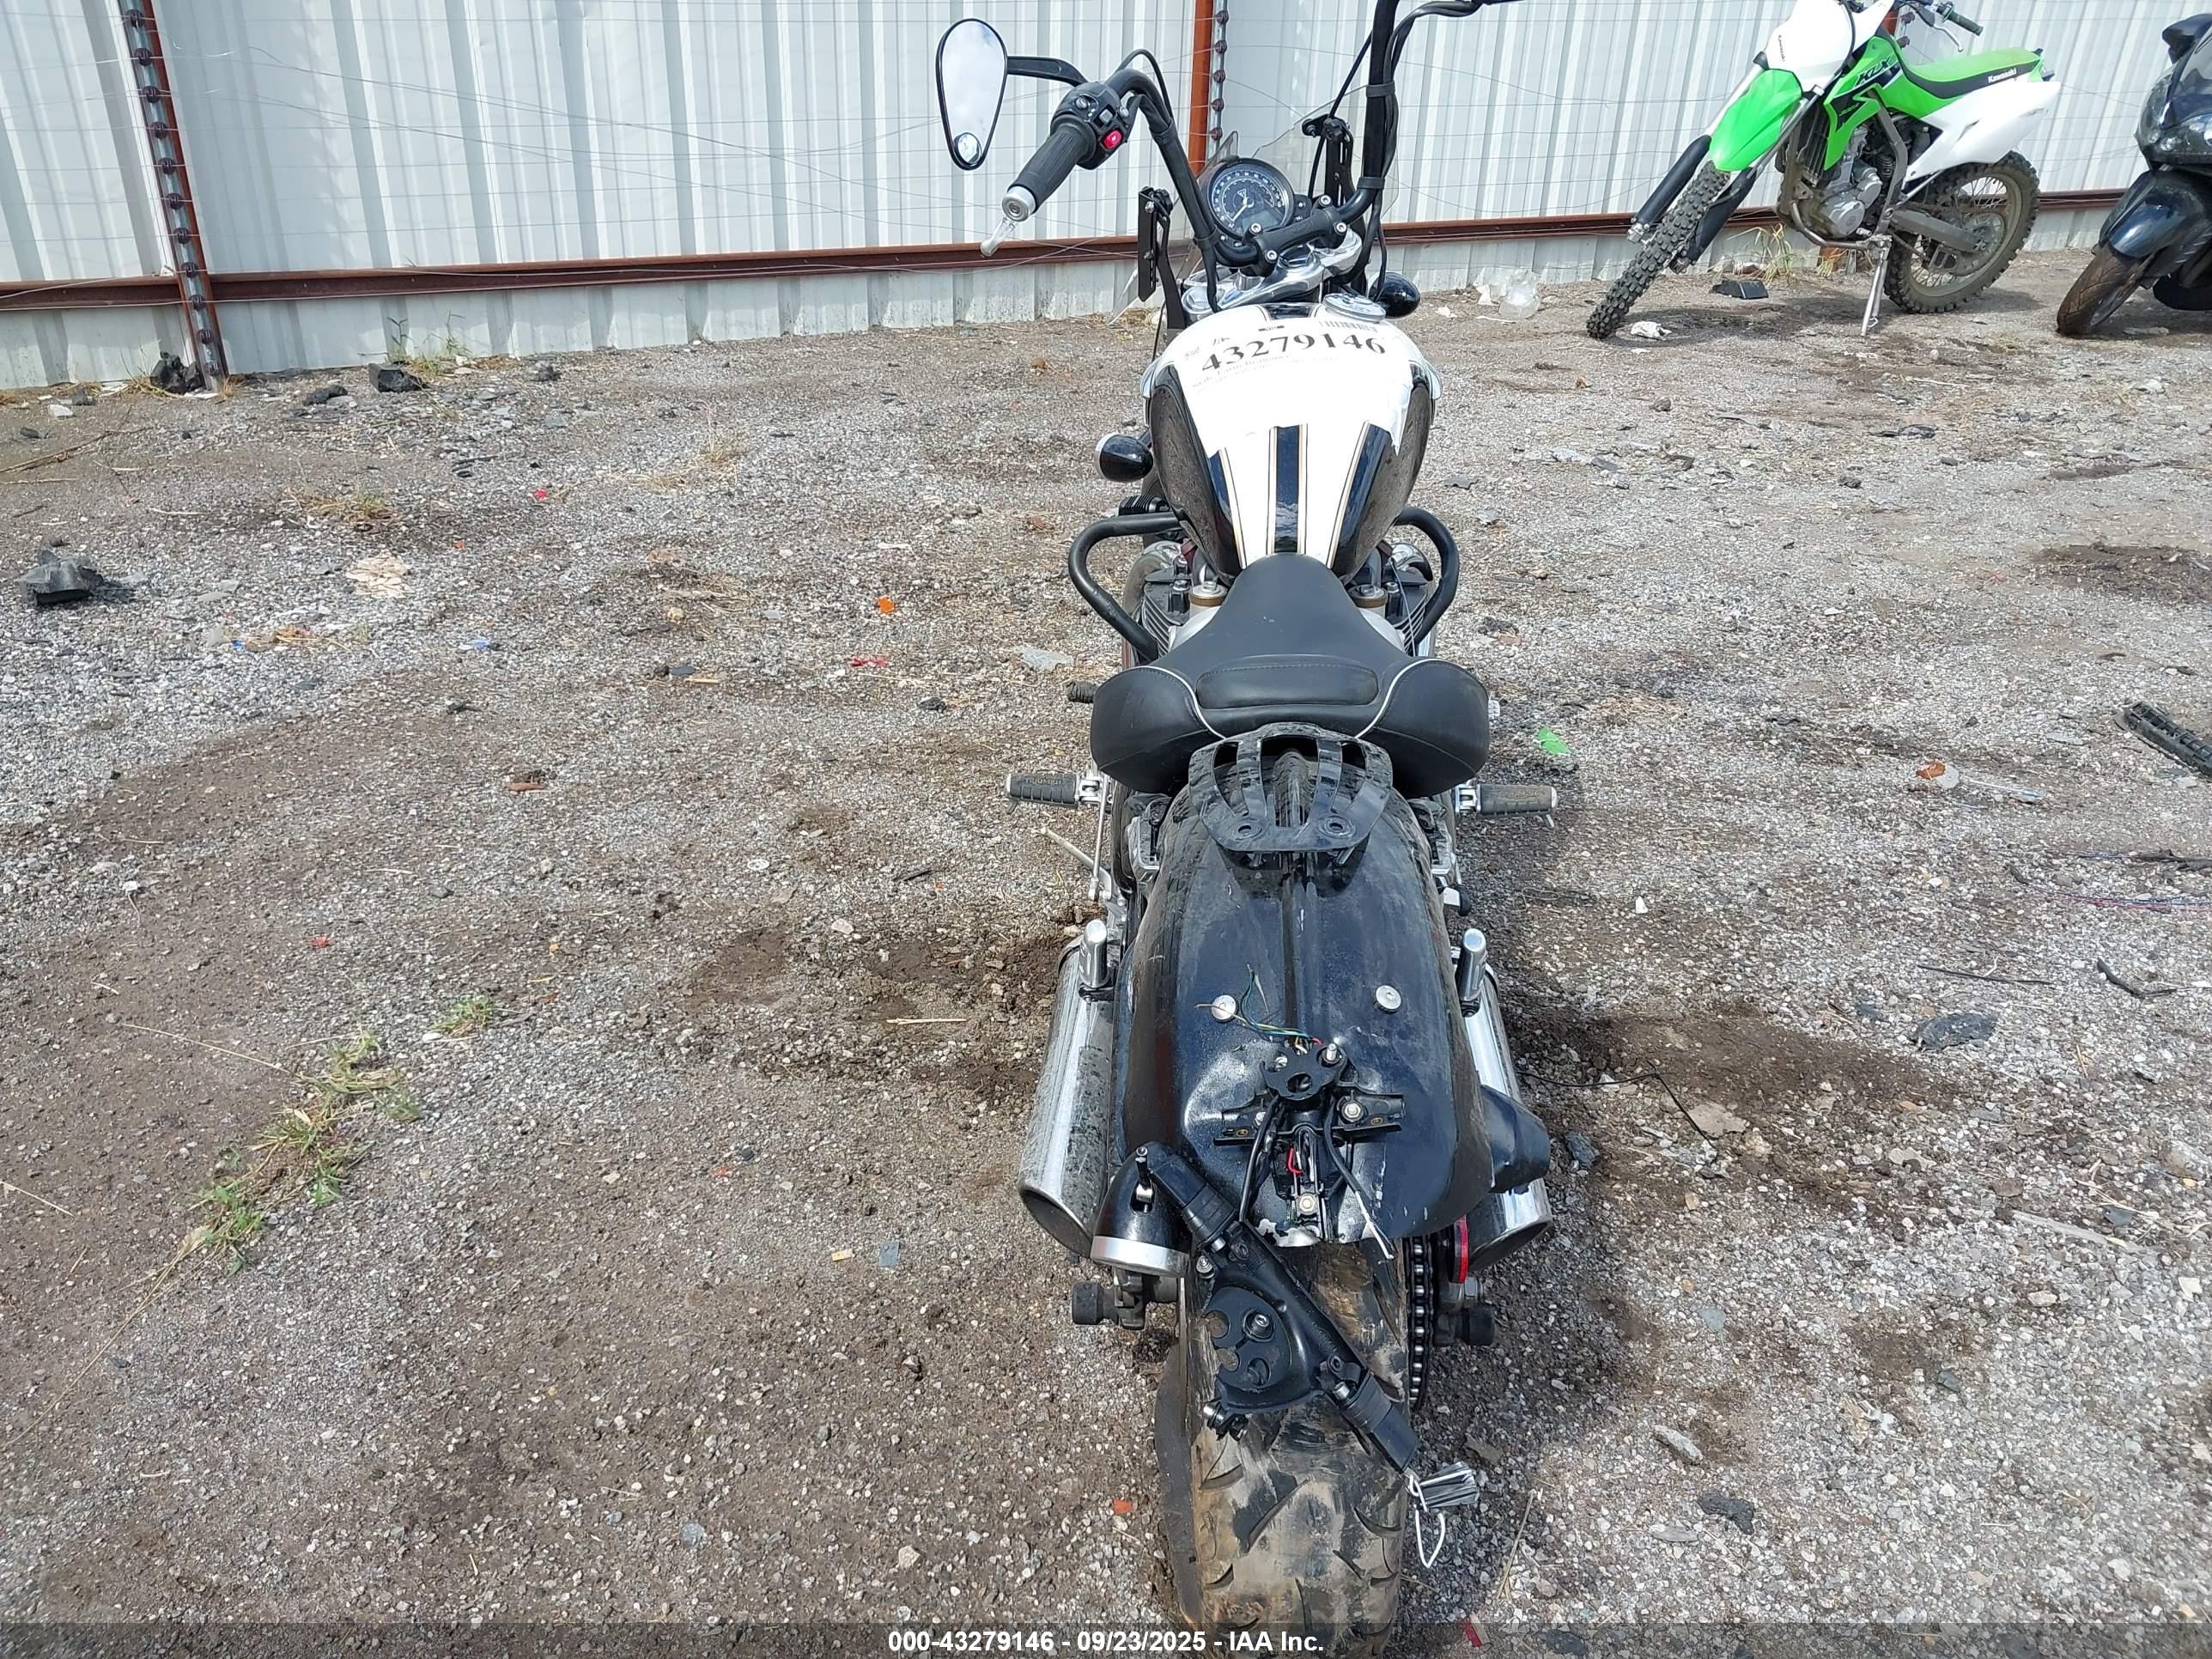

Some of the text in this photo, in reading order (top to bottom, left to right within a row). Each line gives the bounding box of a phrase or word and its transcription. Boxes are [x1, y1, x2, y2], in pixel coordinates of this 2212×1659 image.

[1855, 54, 1892, 86] KLX
[1987, 67, 2017, 83] Kawasaki
[1201, 332, 1386, 371] 43279146
[1024, 777, 1062, 786] TRIUMPH
